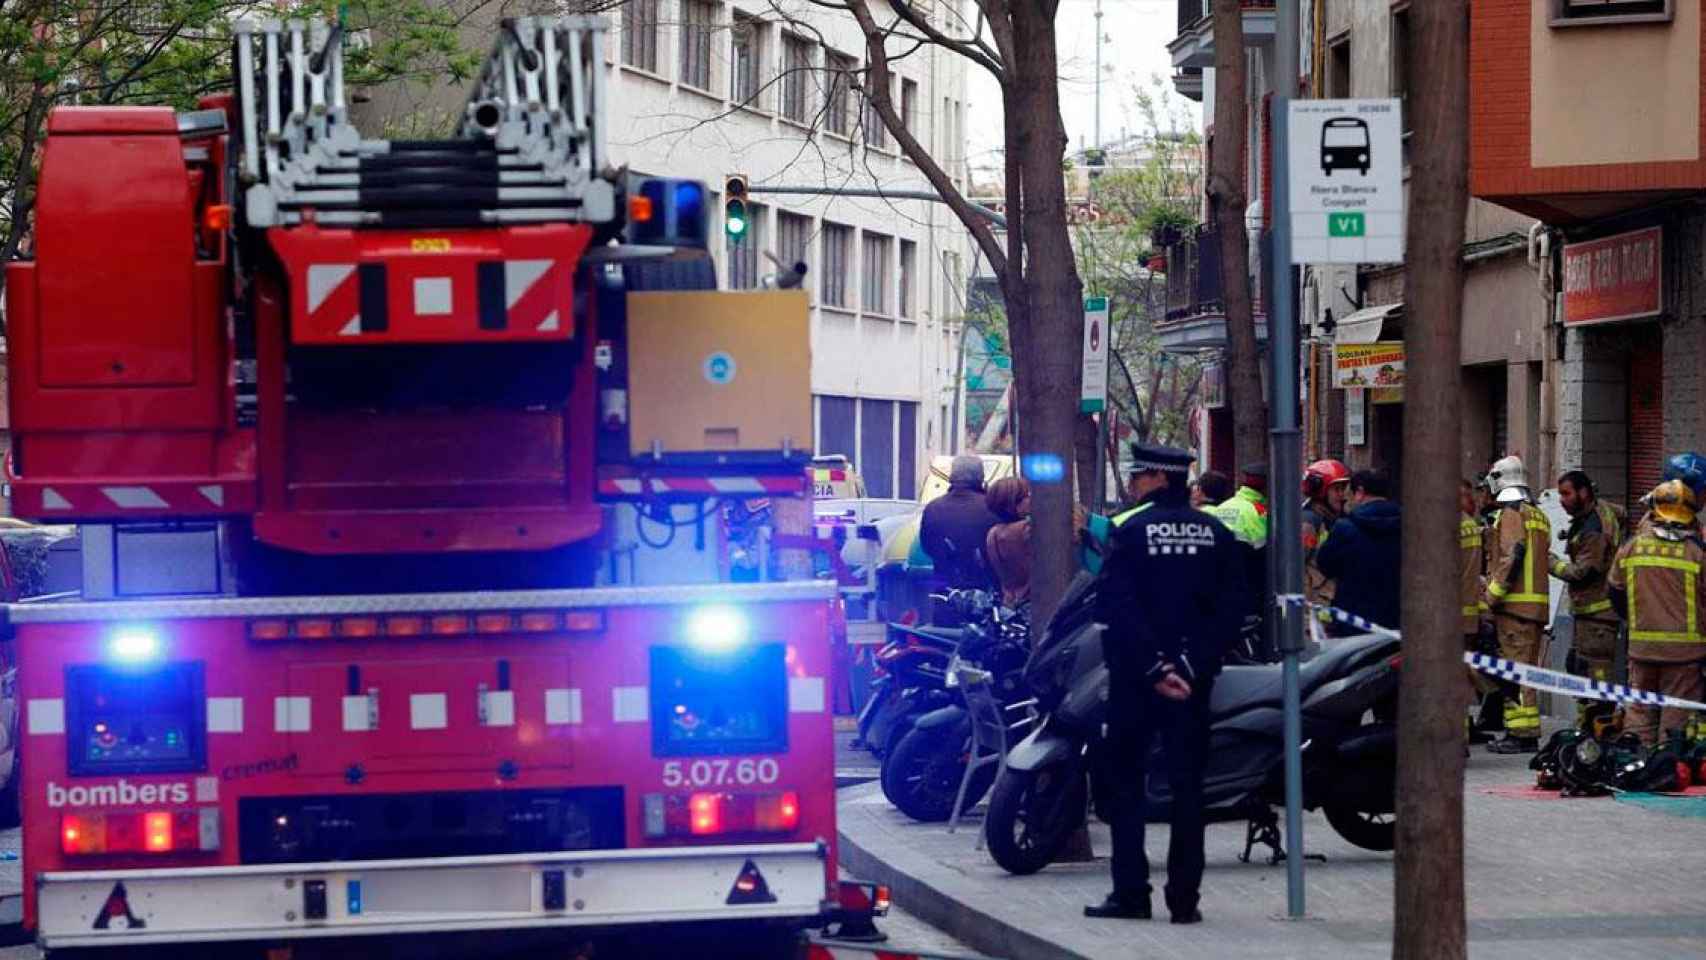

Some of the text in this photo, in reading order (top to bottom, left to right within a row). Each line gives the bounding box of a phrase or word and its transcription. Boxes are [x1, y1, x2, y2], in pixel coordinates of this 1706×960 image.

[1338, 217, 1358, 233] V1
[1145, 523, 1214, 538] POLICIA
[662, 758, 779, 787] 5.07.60
[47, 778, 189, 807] bombers
